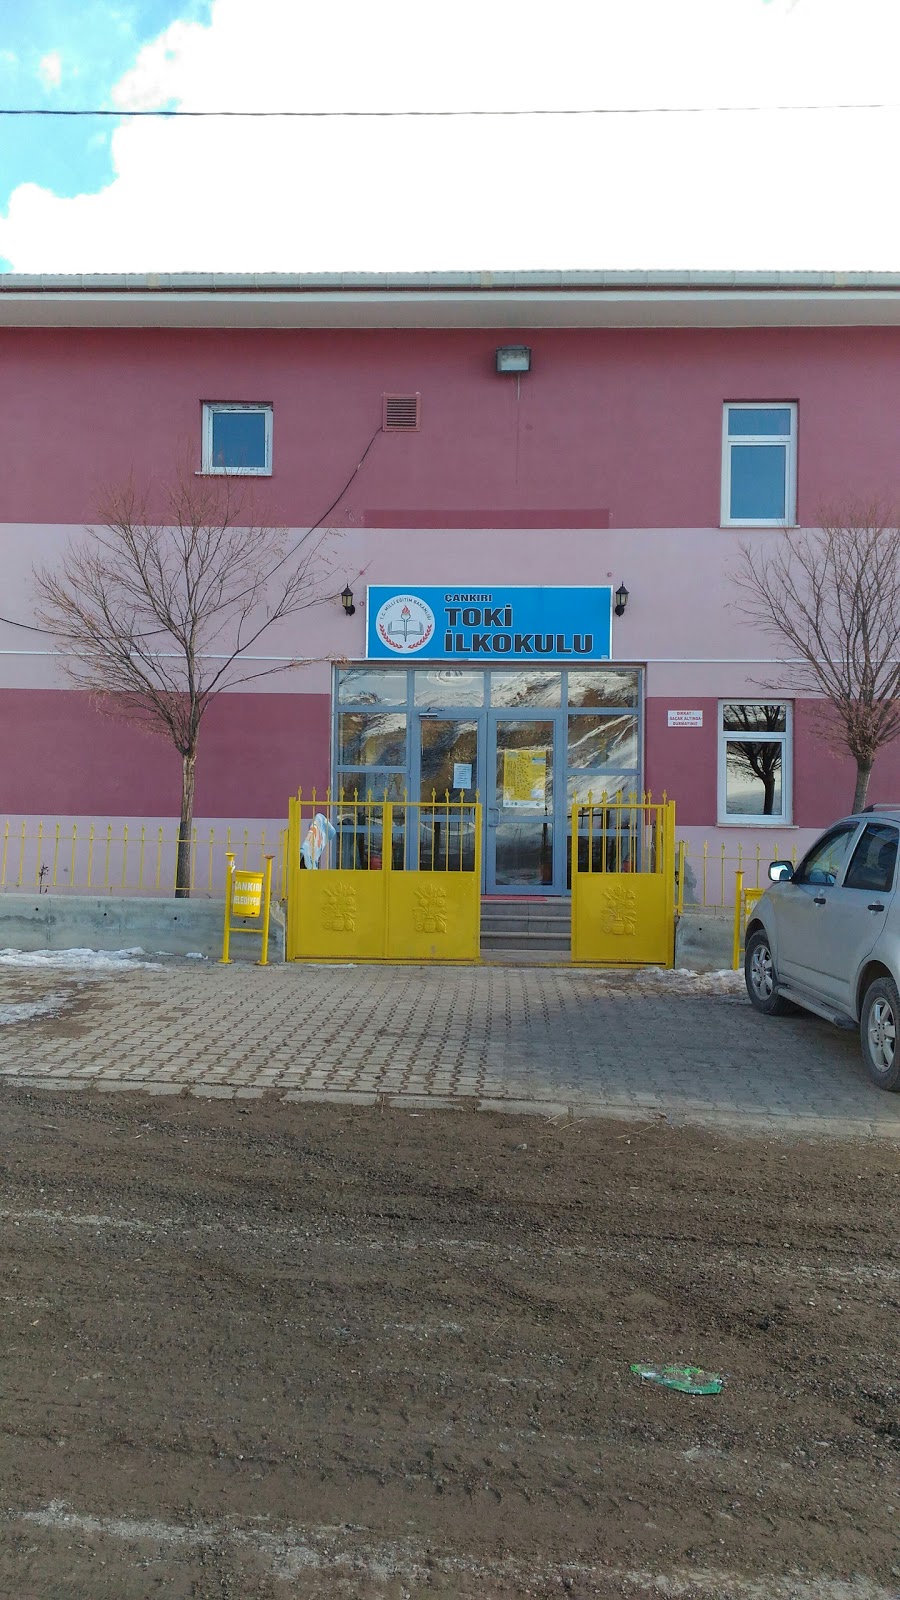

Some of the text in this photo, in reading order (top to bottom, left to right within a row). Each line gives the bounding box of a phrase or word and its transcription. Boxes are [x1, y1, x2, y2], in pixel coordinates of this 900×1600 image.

[444, 594, 492, 602] ÇANKIRI
[444, 604, 512, 627] TOKİ
[444, 630, 593, 653] İLKOKULU
